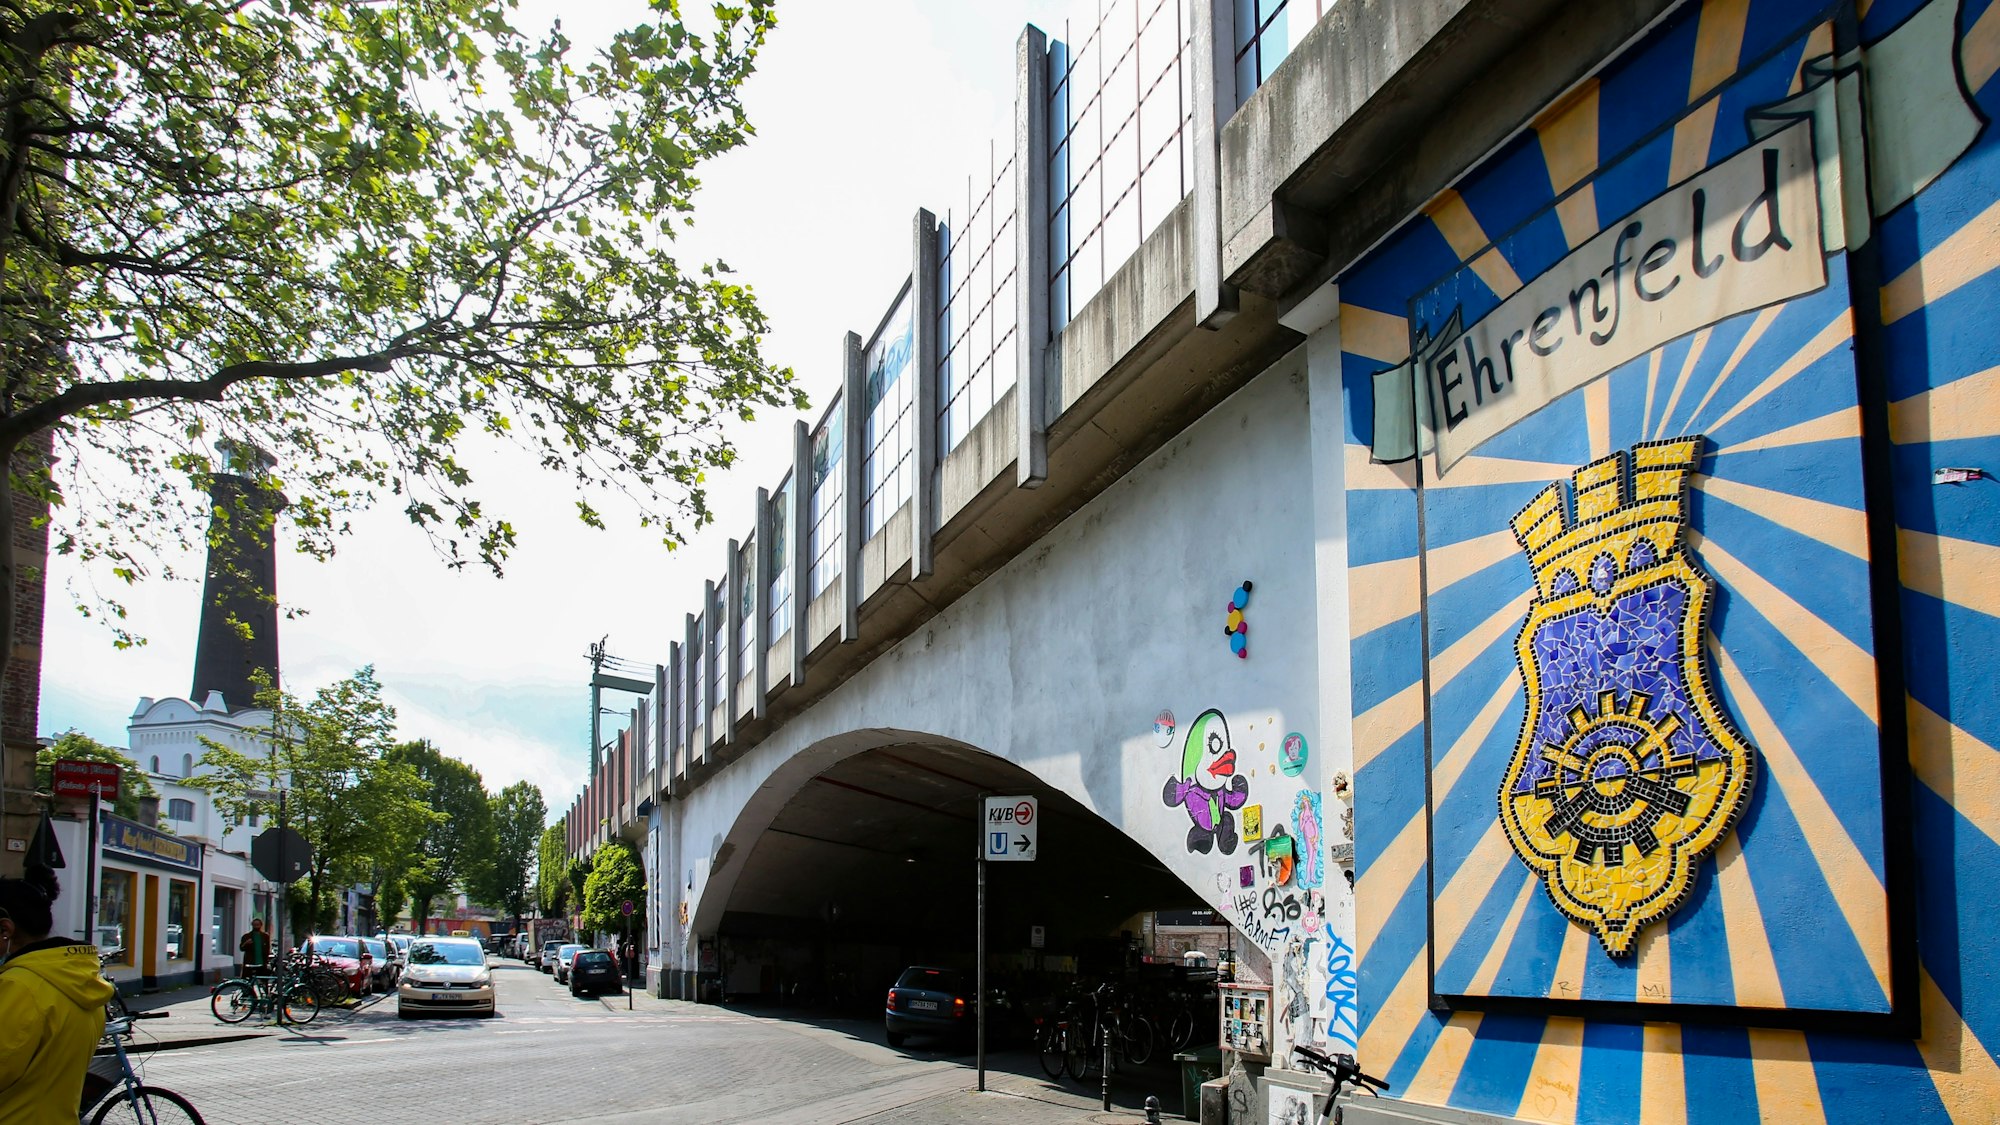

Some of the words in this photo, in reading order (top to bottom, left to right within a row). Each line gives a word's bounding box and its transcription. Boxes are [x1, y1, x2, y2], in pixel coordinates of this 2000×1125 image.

[1436, 148, 1793, 433] Ehrenfeld
[989, 807, 1014, 821] KVB
[991, 833, 1007, 853] U
